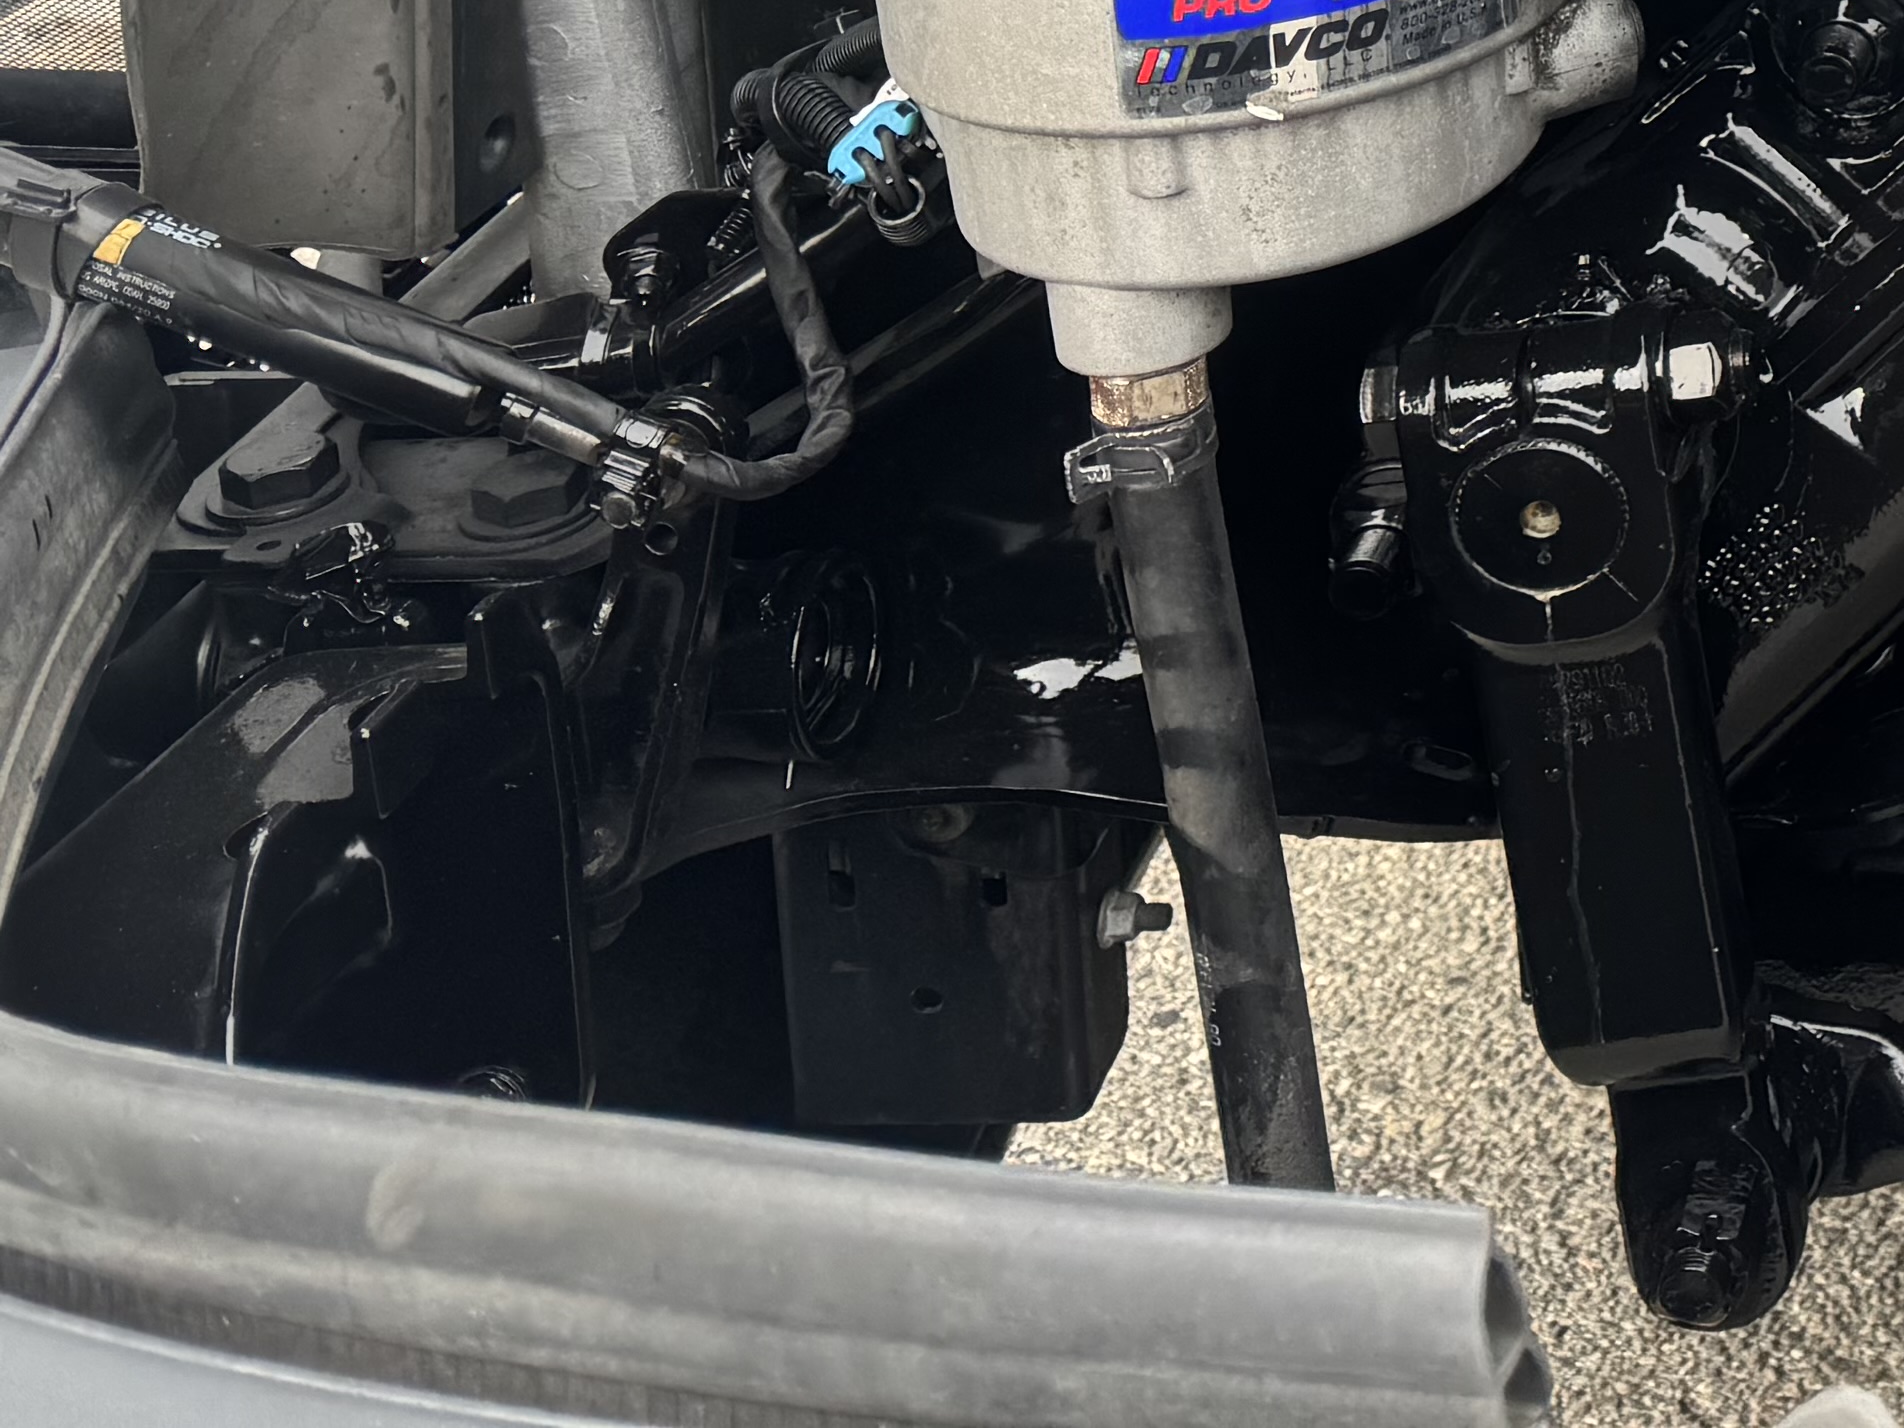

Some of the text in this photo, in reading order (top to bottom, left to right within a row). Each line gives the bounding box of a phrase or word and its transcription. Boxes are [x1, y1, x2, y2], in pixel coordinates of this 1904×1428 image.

[1188, 8, 1390, 80] DAVCO
[1402, 25, 1435, 46] Made
[116, 271, 177, 300] INSTRUCTIONS
